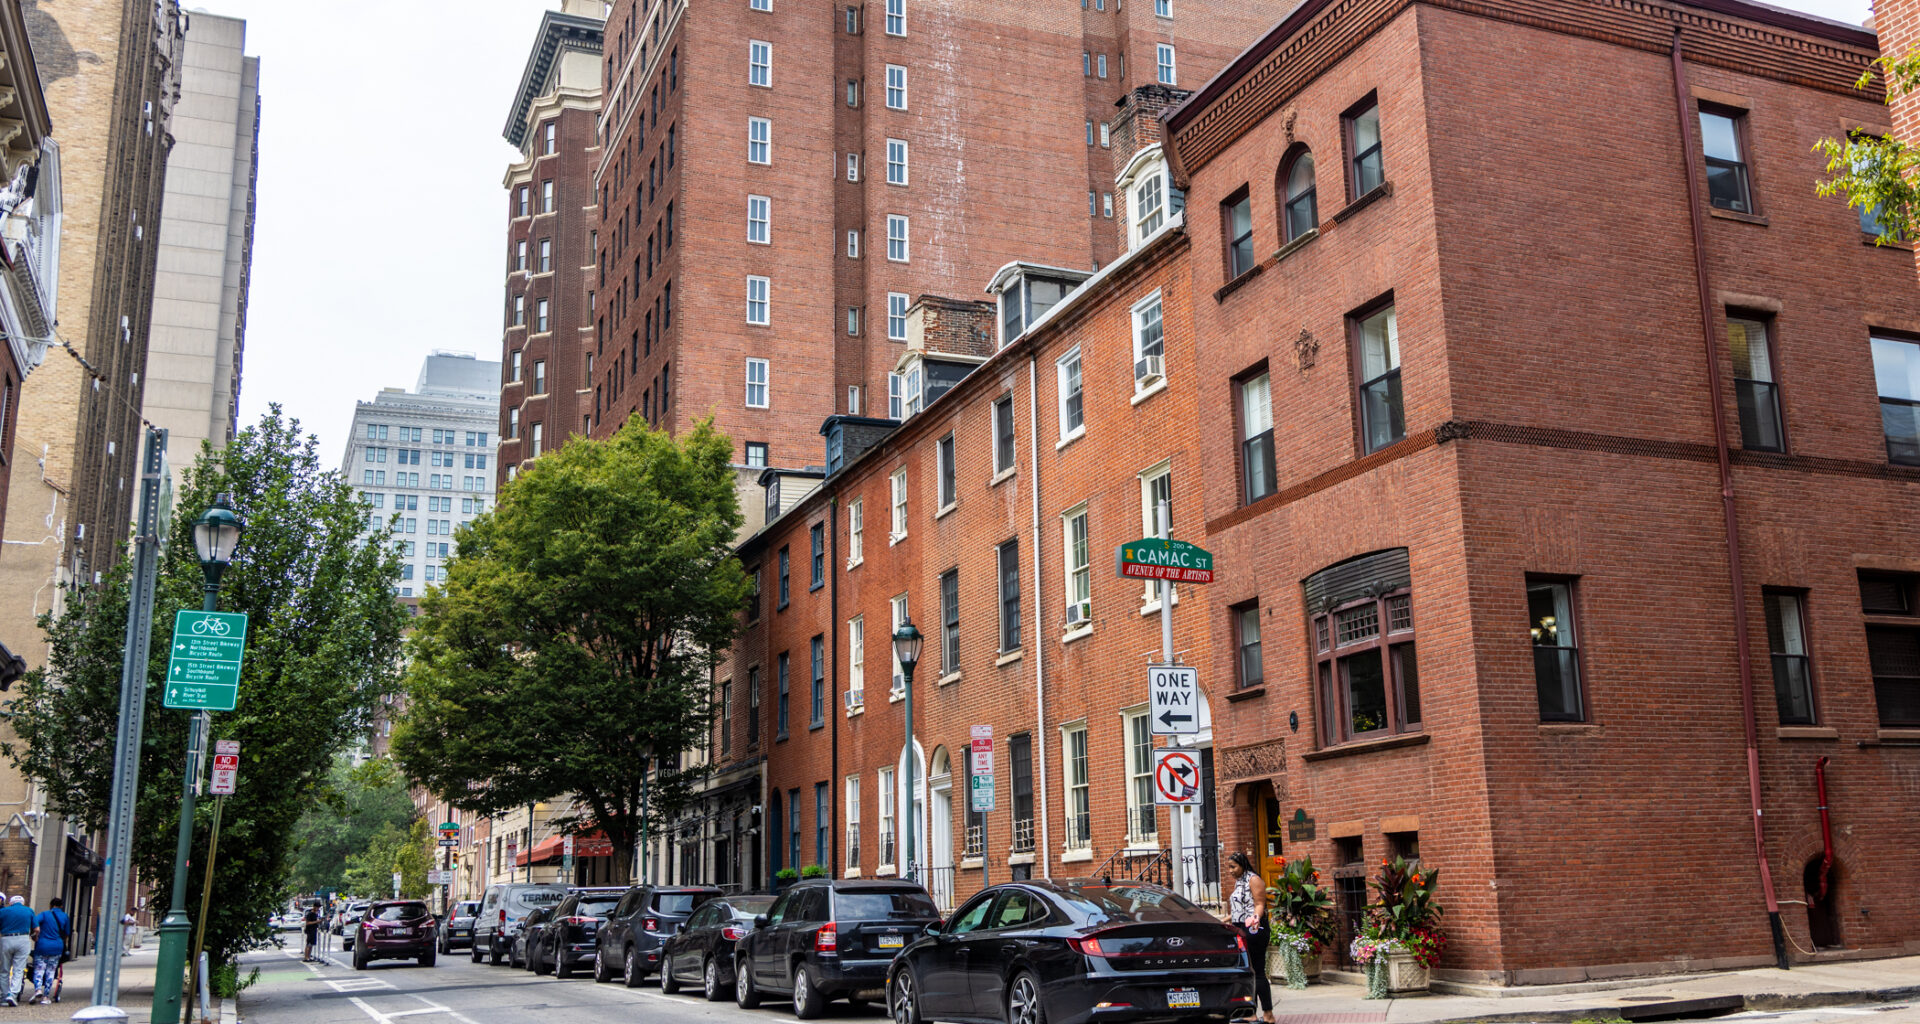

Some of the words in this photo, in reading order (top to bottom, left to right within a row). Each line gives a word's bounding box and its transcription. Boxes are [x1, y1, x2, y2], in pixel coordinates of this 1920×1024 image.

[1164, 541, 1170, 550] S
[1137, 548, 1190, 567] CAMAC
[1196, 558, 1207, 568] ST
[1126, 564, 1154, 576] AVENUE
[1156, 568, 1164, 578] OF
[1166, 568, 1180, 578] THE
[1182, 570, 1210, 581] ARTISTS
[1156, 673, 1190, 688] ONE
[1156, 691, 1191, 706] WAY
[974, 777, 979, 788] 2
[522, 894, 563, 902] TERMAC
